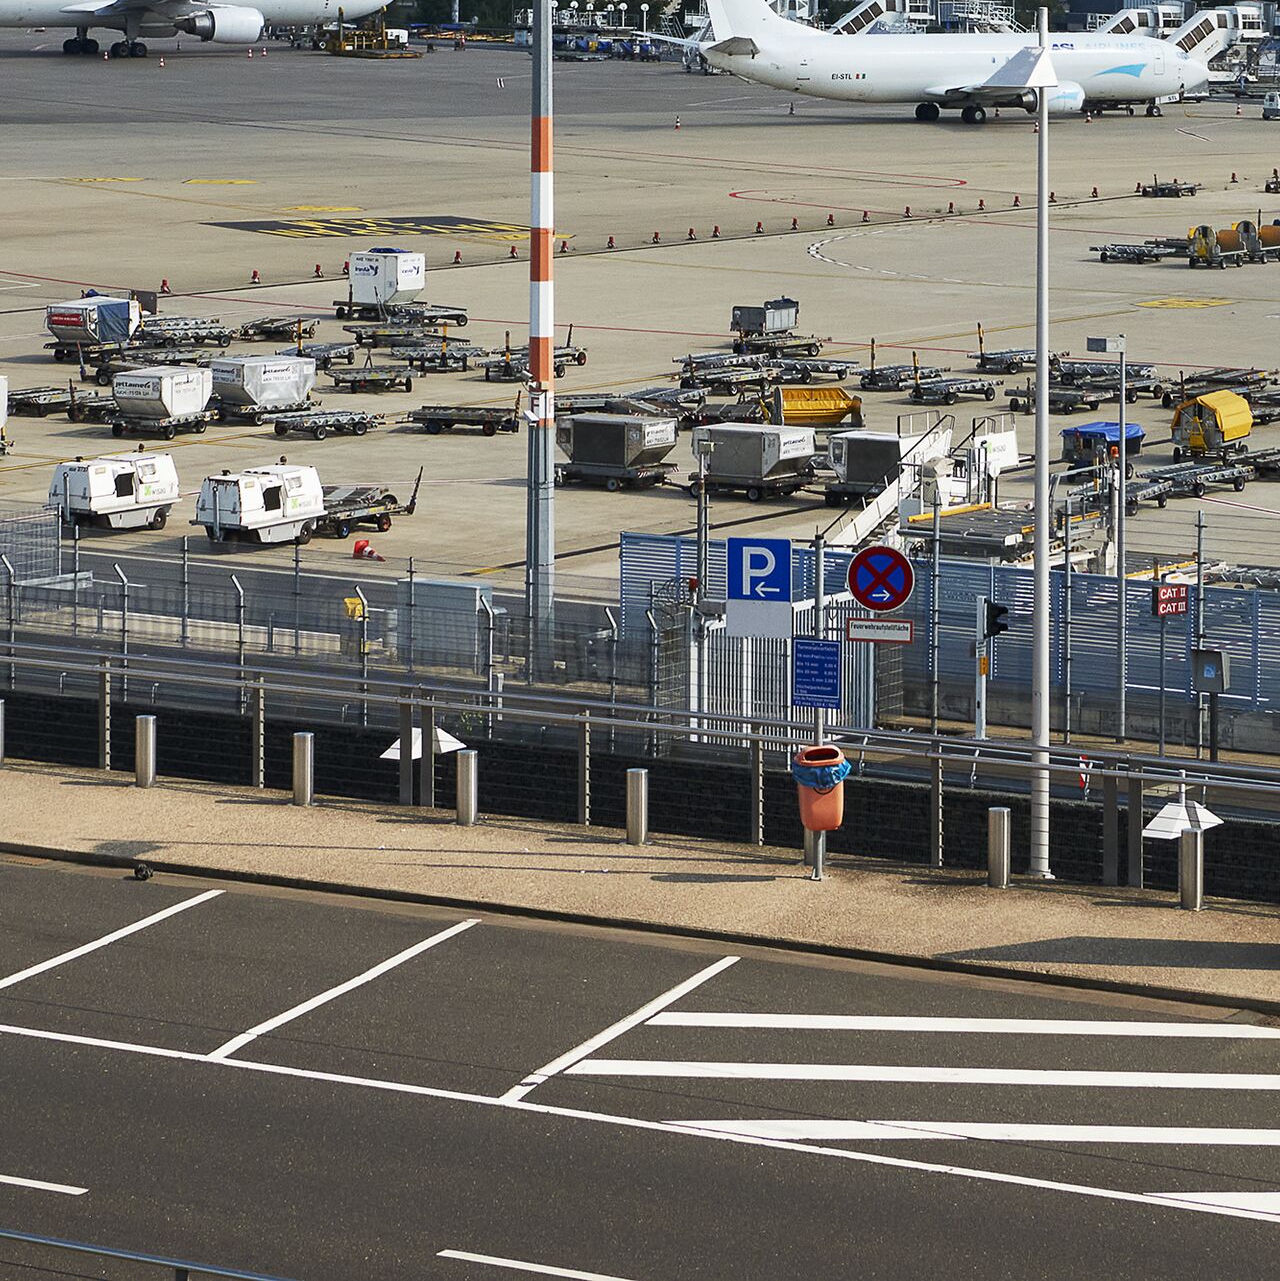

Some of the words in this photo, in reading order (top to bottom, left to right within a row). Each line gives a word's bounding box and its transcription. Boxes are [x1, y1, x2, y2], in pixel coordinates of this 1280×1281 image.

[742, 546, 776, 596] P
[1160, 588, 1178, 599] CAT
[1180, 587, 1186, 597] II
[1159, 602, 1178, 614] CAT
[1177, 601, 1187, 612] III
